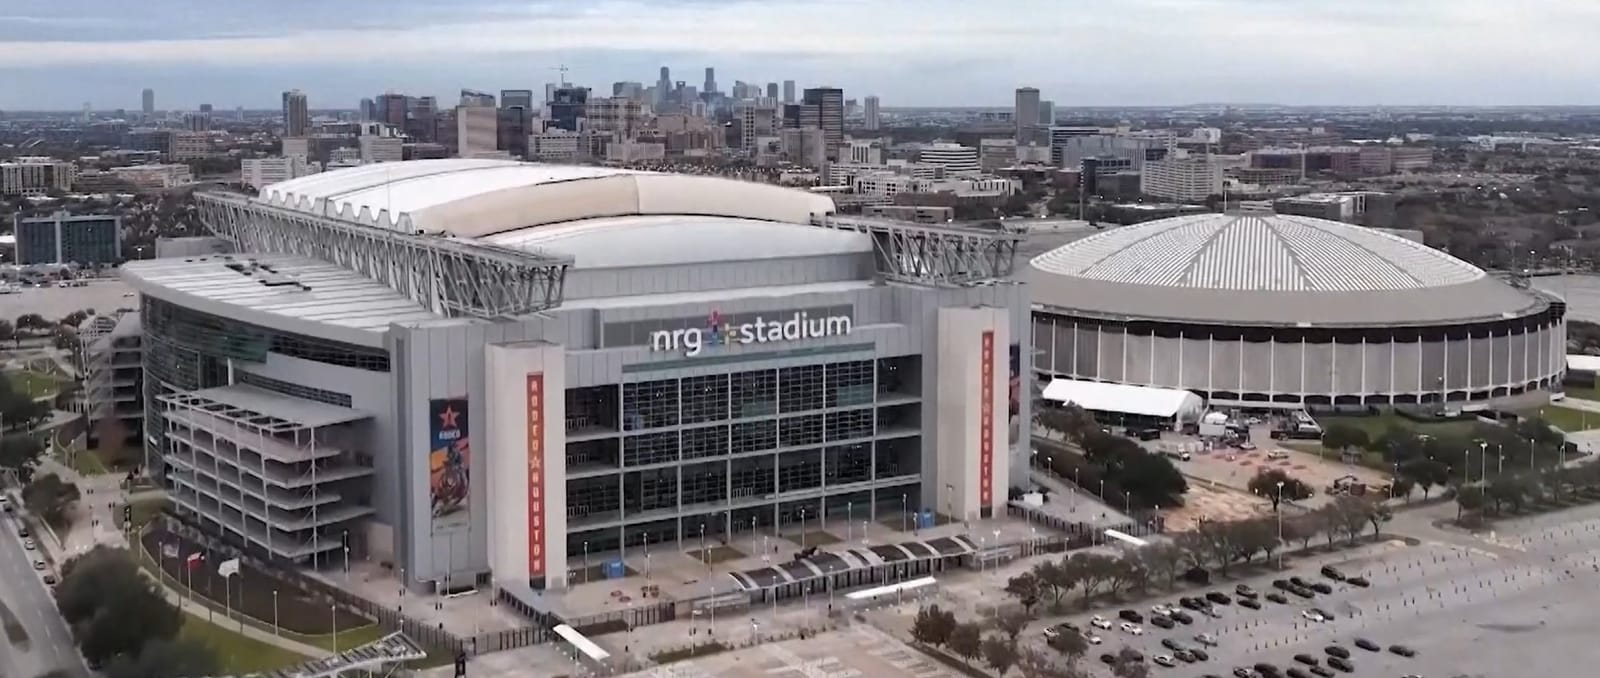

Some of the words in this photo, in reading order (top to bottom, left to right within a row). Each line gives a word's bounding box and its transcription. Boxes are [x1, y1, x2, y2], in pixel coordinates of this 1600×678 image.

[652, 327, 702, 357] nrg
[740, 311, 851, 344] stadium
[531, 471, 540, 571] HOUSTON
